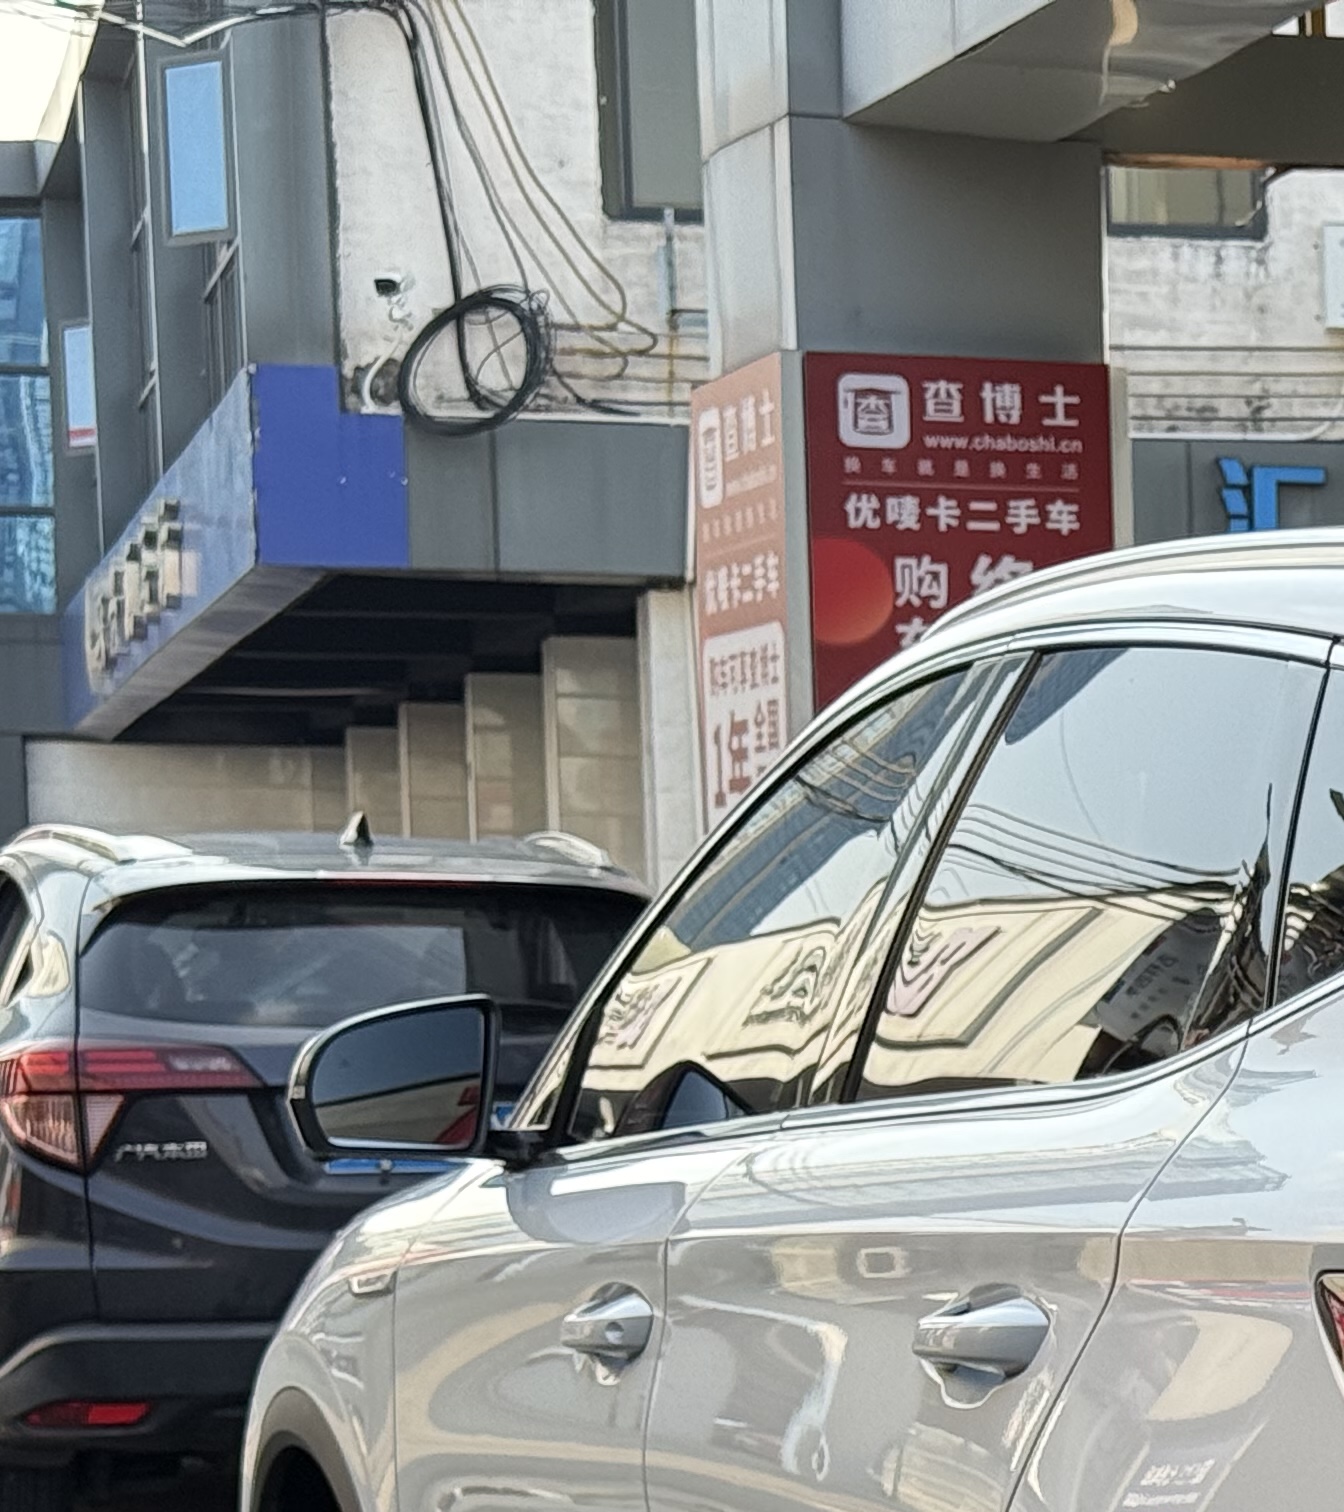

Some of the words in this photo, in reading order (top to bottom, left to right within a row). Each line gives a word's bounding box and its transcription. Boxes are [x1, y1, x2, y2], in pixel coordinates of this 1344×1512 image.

[922, 380, 1081, 427] 查博士
[922, 434, 1083, 454] www.chaboshi.cn
[844, 493, 1080, 536] 优唛卡二手车
